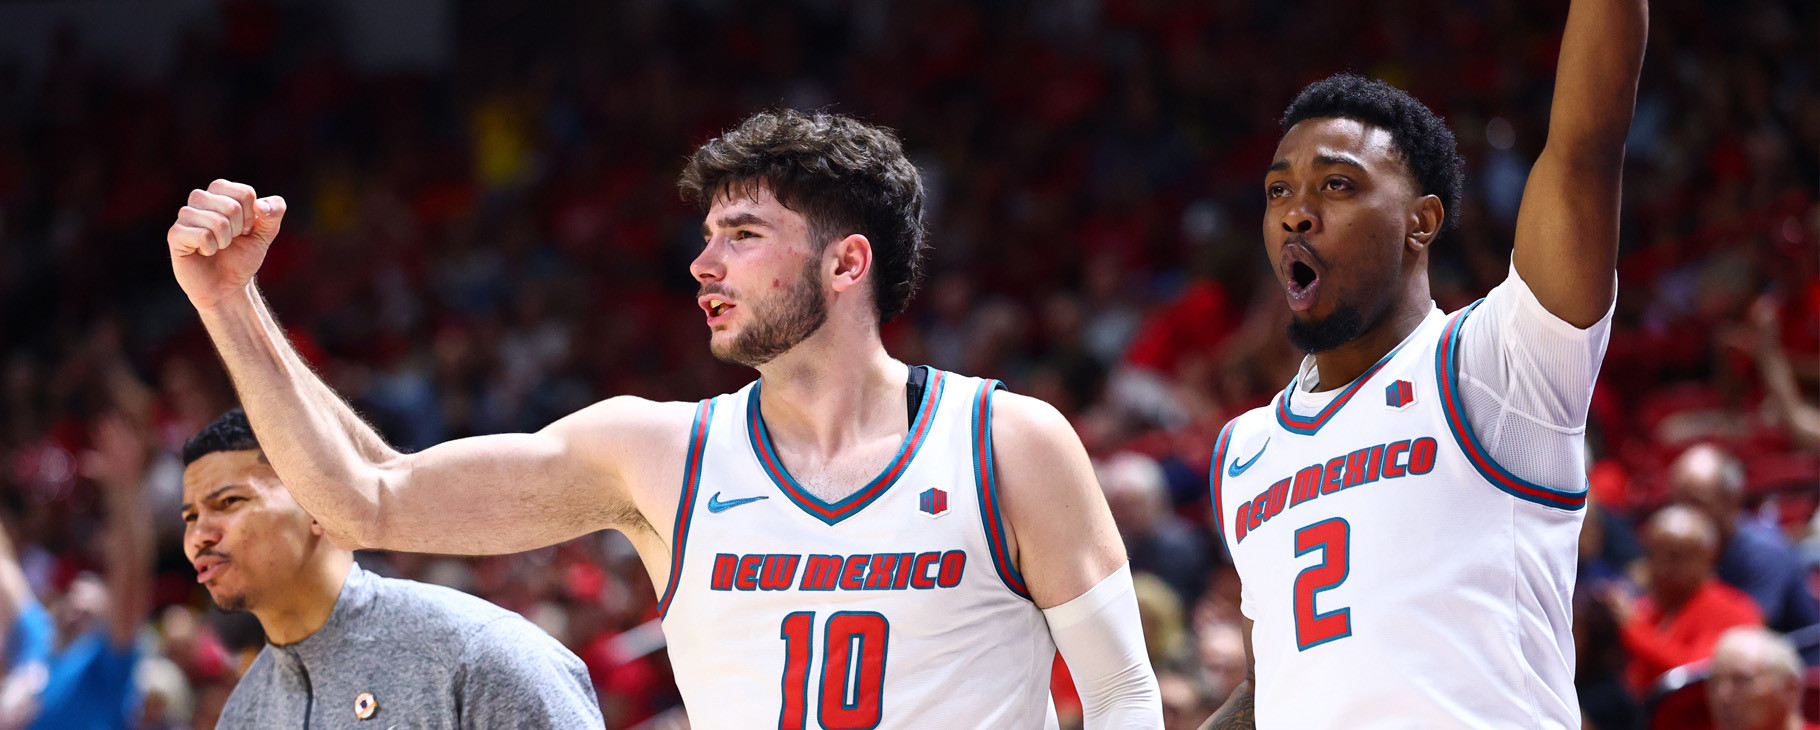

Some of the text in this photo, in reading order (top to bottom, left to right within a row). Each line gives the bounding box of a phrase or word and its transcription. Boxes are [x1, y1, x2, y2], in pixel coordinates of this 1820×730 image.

[1235, 436, 1438, 544] NEW MEXICO
[710, 549, 967, 591] NEW MEXICO
[1293, 516, 1352, 652] 2
[777, 610, 890, 730] 10
